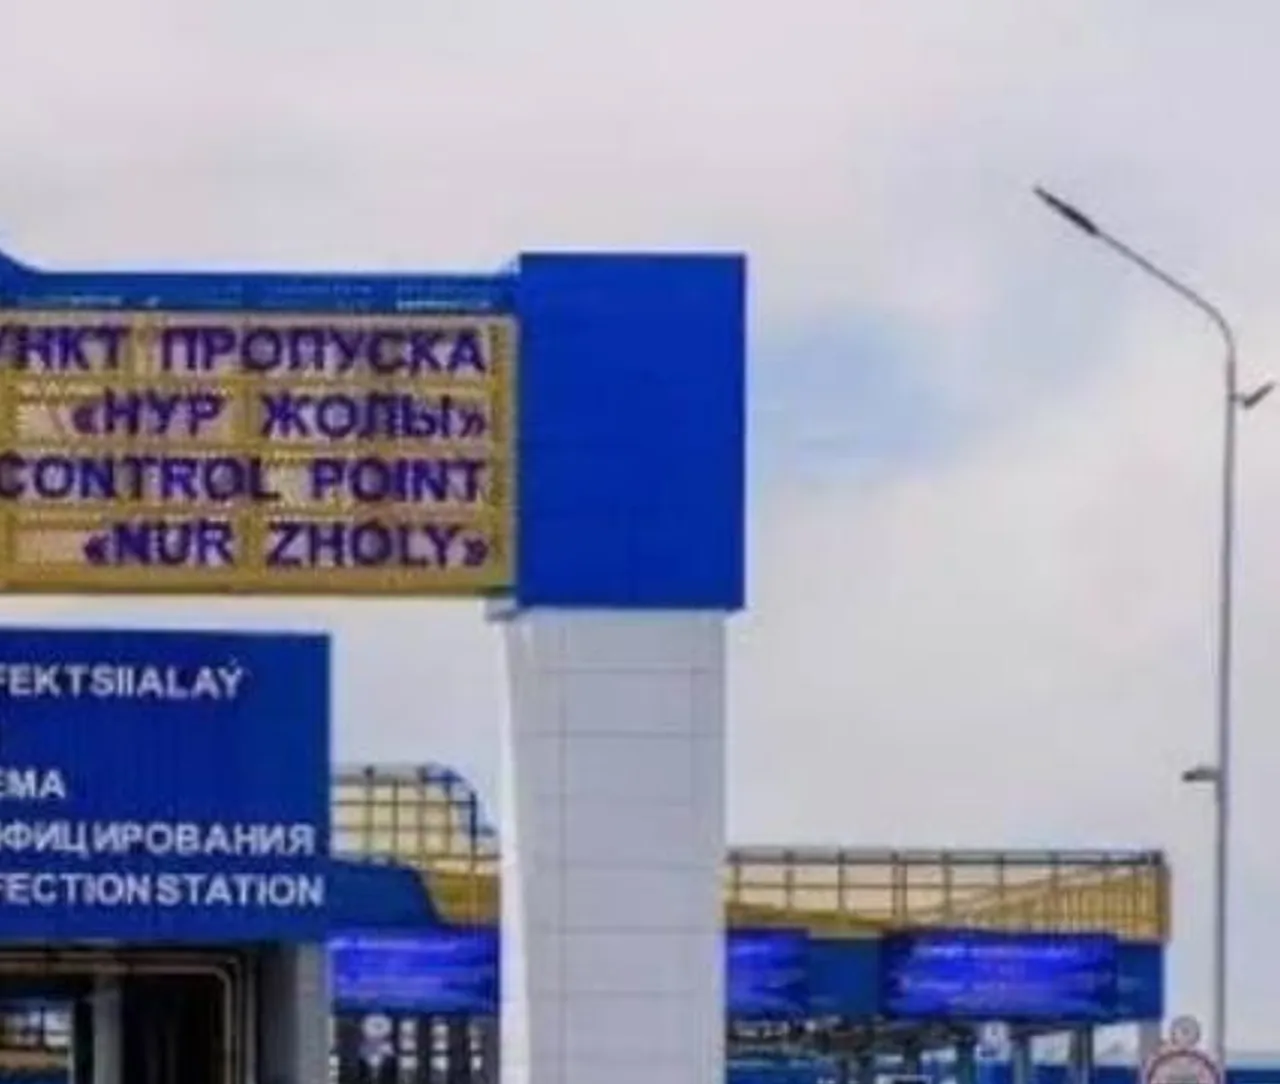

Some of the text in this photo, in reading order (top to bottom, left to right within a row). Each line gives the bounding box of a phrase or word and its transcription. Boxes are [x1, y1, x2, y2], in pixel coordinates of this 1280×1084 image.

[160, 327, 486, 373] ПРОПУСКА
[72, 389, 487, 439] «НУР ЖОЛЫ»
[310, 456, 487, 502] POINT
[83, 517, 491, 568] «NUR ZHOLY»
[155, 872, 326, 908] STATION
